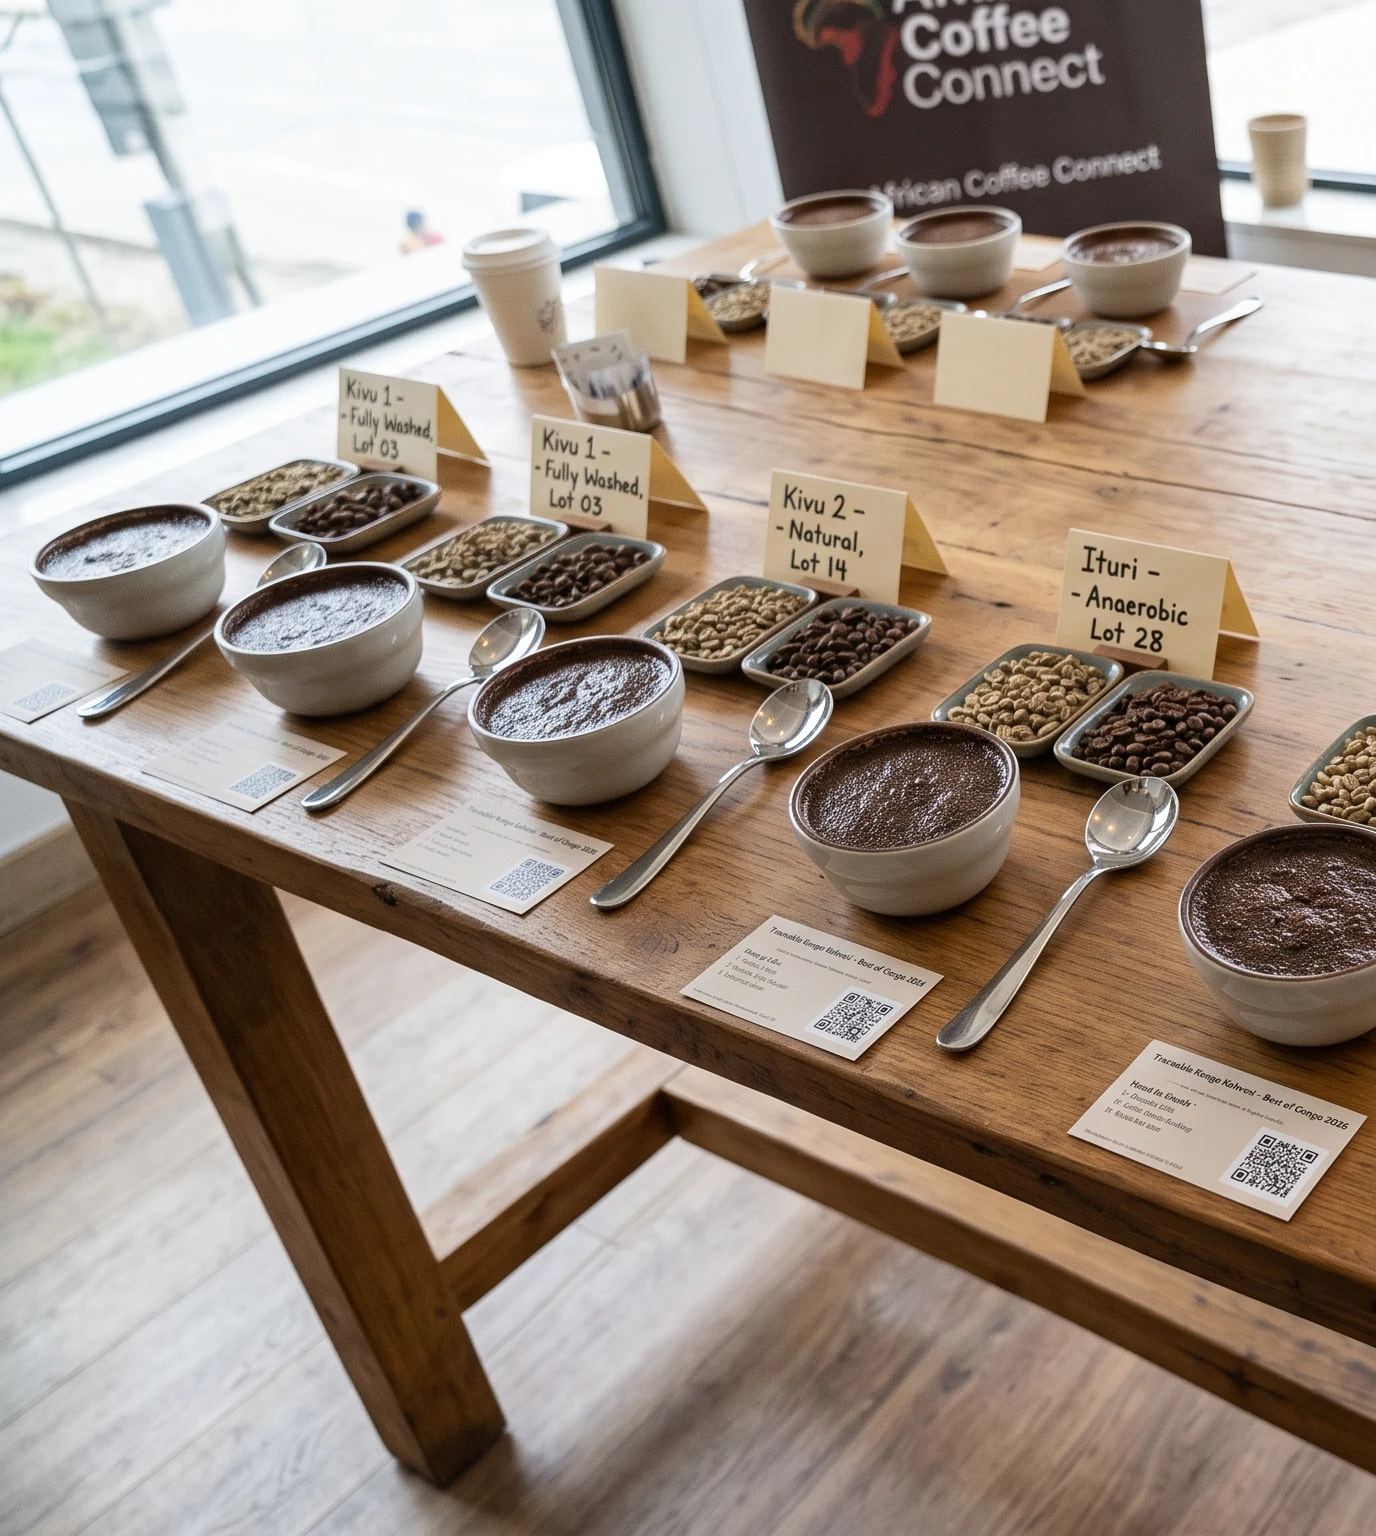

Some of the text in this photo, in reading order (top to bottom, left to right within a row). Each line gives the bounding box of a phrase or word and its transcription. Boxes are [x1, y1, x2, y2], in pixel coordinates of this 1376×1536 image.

[900, 3, 1071, 61] Coffee
[902, 42, 1106, 109] Connect
[963, 161, 1051, 198] Coffee
[1052, 143, 1163, 185] Connect
[346, 377, 378, 404] Kivu
[383, 384, 392, 408] 1
[350, 405, 380, 438] Fully
[384, 414, 433, 442] Washed,
[353, 433, 399, 461] Lot 03
[542, 427, 579, 457] Kivu
[584, 435, 596, 460] 1
[545, 458, 579, 493] Fully
[584, 467, 644, 501] Washed,
[549, 488, 603, 517] Lot 03
[783, 483, 826, 516] Kivu
[831, 494, 847, 521] 2
[788, 518, 864, 558] Natural,
[790, 548, 848, 582] Lot 14
[1081, 545, 1138, 581] Ituri
[1085, 584, 1189, 627] Anaerobic
[1090, 617, 1164, 653] Lot 28
[1282, 1102, 1296, 1110] of
[1294, 1105, 1324, 1121] Congo
